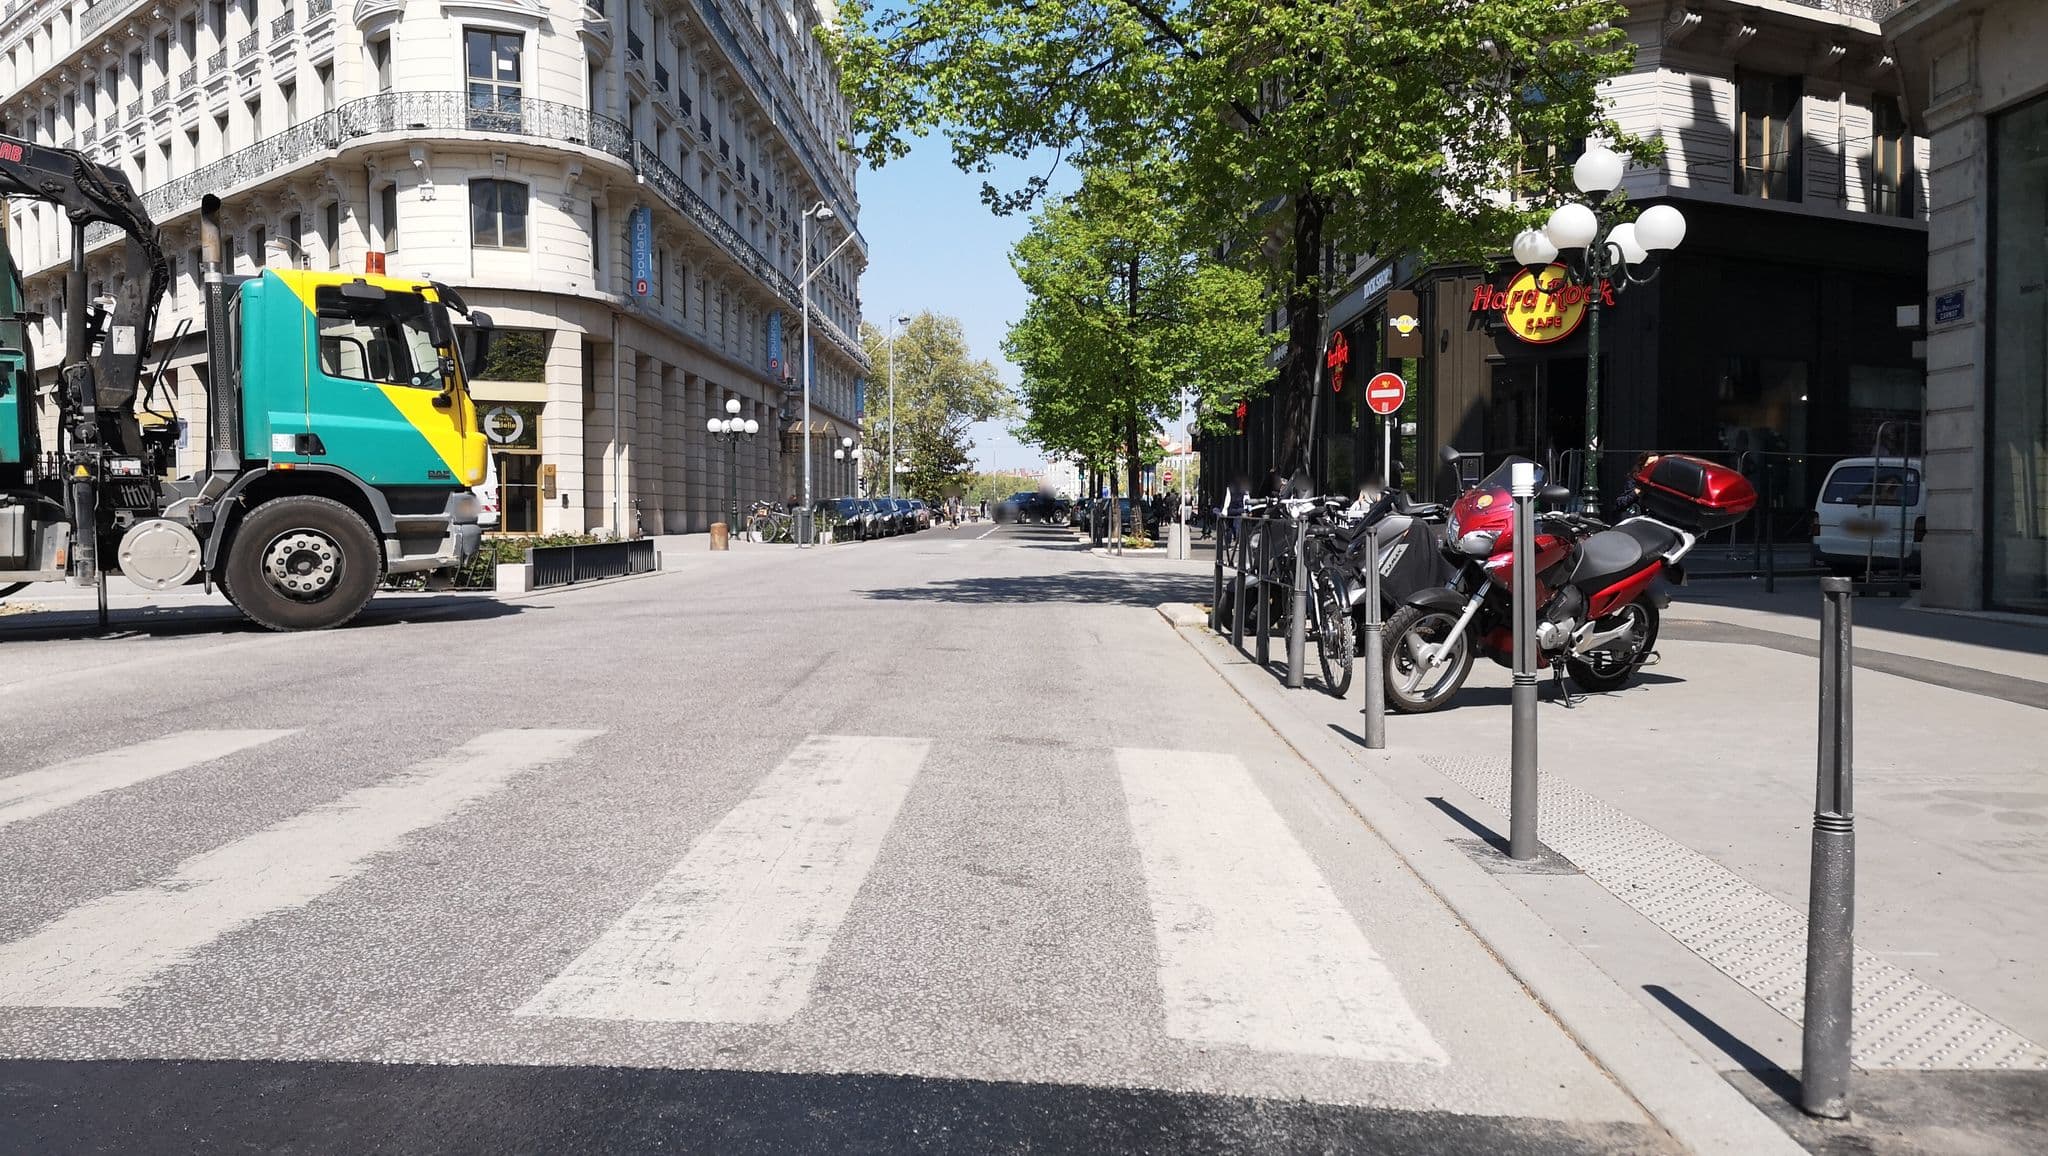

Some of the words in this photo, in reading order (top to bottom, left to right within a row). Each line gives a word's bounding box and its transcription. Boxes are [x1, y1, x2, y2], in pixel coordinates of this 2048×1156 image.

[0, 141, 23, 162] AB
[1471, 280, 1544, 312] Hard
[1545, 278, 1616, 313] Rock
